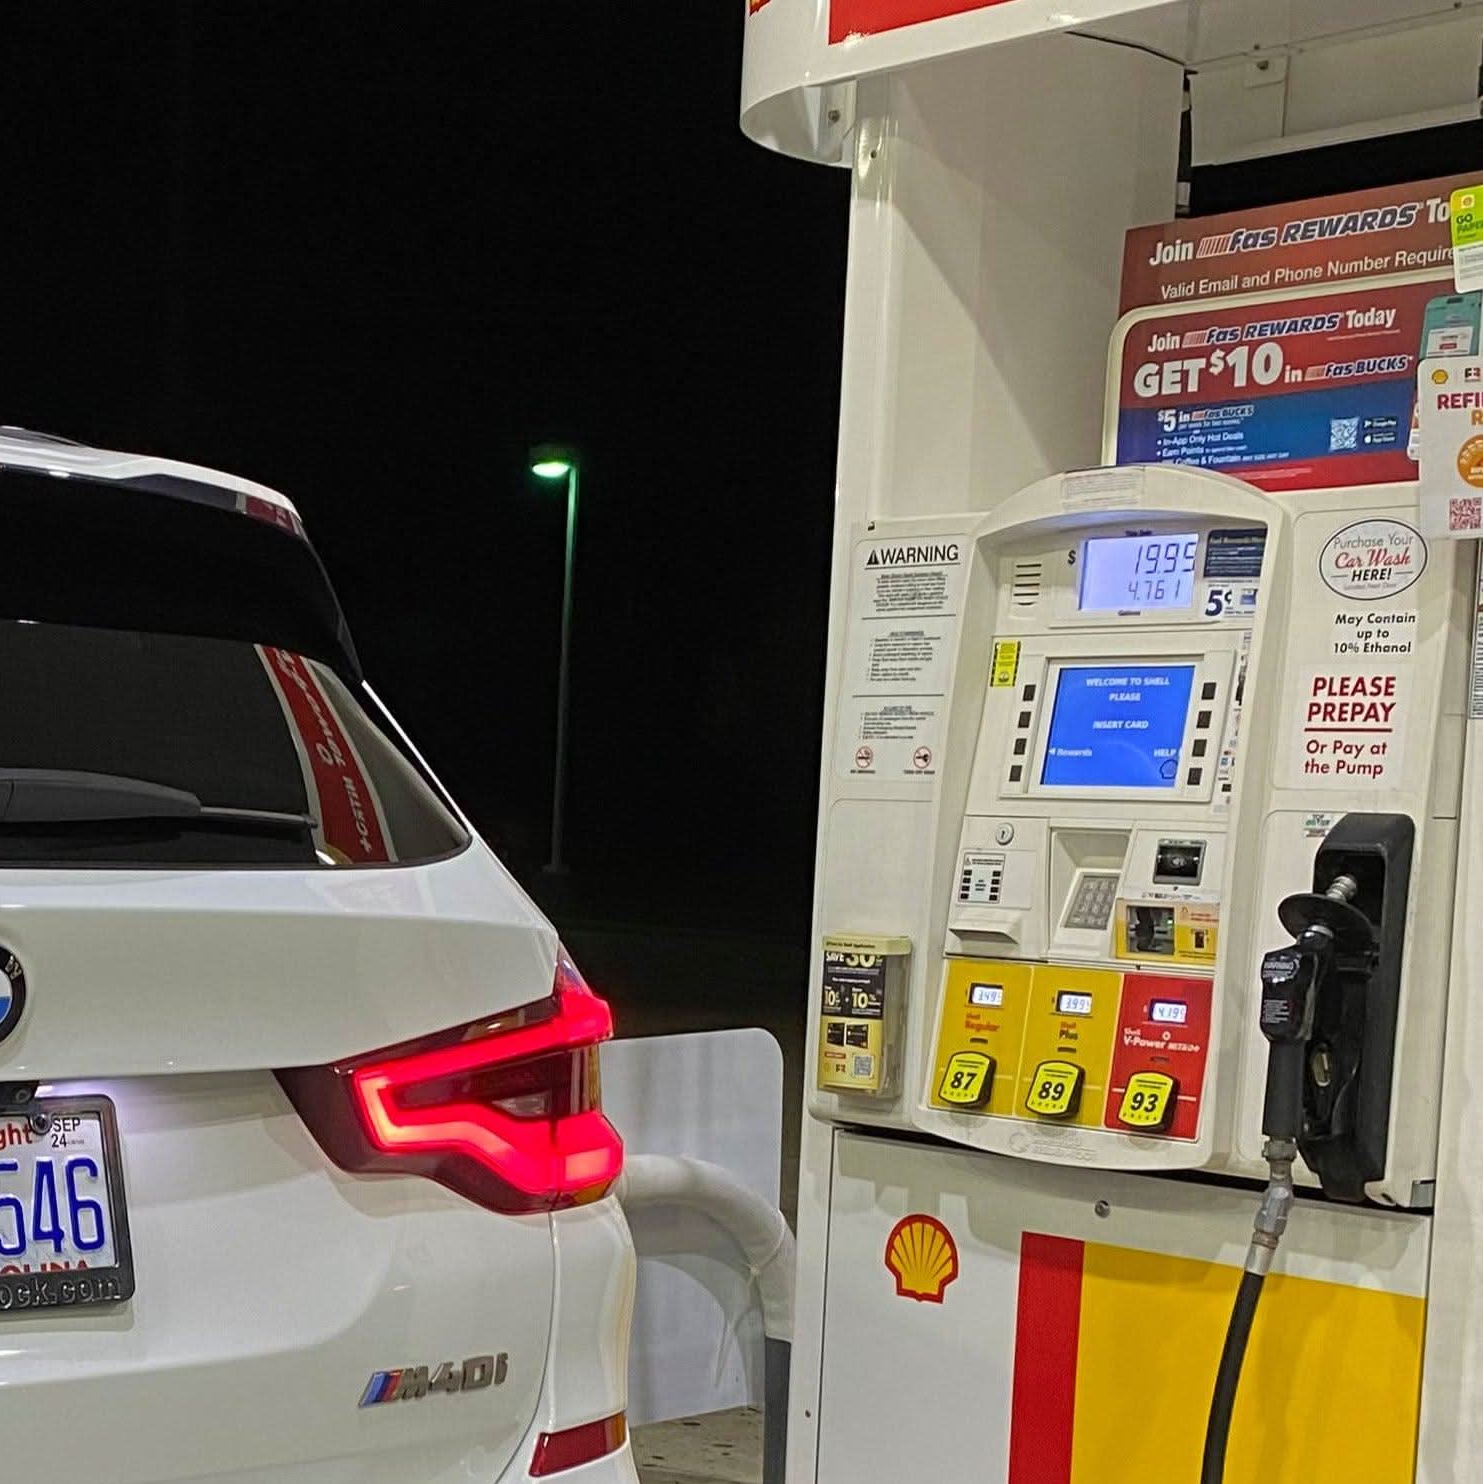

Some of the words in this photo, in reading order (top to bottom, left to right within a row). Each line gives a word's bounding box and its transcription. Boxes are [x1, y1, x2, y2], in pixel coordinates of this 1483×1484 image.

[1149, 239, 1194, 266] Join
[1281, 202, 1419, 246] REWARDS
[1427, 197, 1452, 224] To
[1161, 283, 1195, 300] Valid
[1199, 273, 1238, 294] Email
[1242, 271, 1270, 288] and
[1274, 263, 1323, 285] Phone
[1327, 254, 1391, 277] Number
[1394, 245, 1454, 267] Require
[1147, 332, 1181, 354] Join
[1243, 313, 1341, 341] REWARDS
[1346, 308, 1397, 329] Today
[1133, 355, 1207, 399] GET
[1209, 340, 1285, 389] $10
[1284, 364, 1303, 383] in
[1437, 391, 1483, 411] REFI
[1157, 408, 1176, 432] $5
[1178, 410, 1191, 422] in
[1333, 535, 1384, 550] Purchase
[1388, 533, 1414, 547] Your
[880, 544, 959, 565] WARNING
[1067, 549, 1077, 566] $
[1334, 552, 1364, 569] Car
[1367, 547, 1412, 567] Wash
[1351, 567, 1392, 582] HERE!
[1335, 613, 1364, 627] May
[1367, 612, 1417, 625] Contain
[1357, 629, 1373, 640] up
[1377, 628, 1390, 639] to
[1363, 641, 1412, 654] Ethanol
[1086, 678, 1128, 687] WELCOME
[1130, 677, 1142, 686] TO
[1143, 676, 1171, 686] SHELL
[1312, 676, 1397, 698] PLEASE
[1109, 692, 1141, 701] PLEASE
[1306, 701, 1397, 723] PREPAY
[1092, 720, 1123, 730] INSERT
[1124, 720, 1149, 729] CARD
[1154, 748, 1176, 758] HELP
[1306, 739, 1328, 754] Or
[1332, 740, 1365, 758] Pay
[1370, 741, 1388, 756] at
[1304, 758, 1330, 774] the
[1335, 760, 1384, 779] Pump
[1123, 1036, 1166, 1049] V-Power
[950, 1071, 978, 1091] 87
[1038, 1081, 1065, 1101] 89
[1130, 1091, 1159, 1113] 93
[52, 1117, 81, 1132] SEP
[51, 1133, 67, 1148] 24
